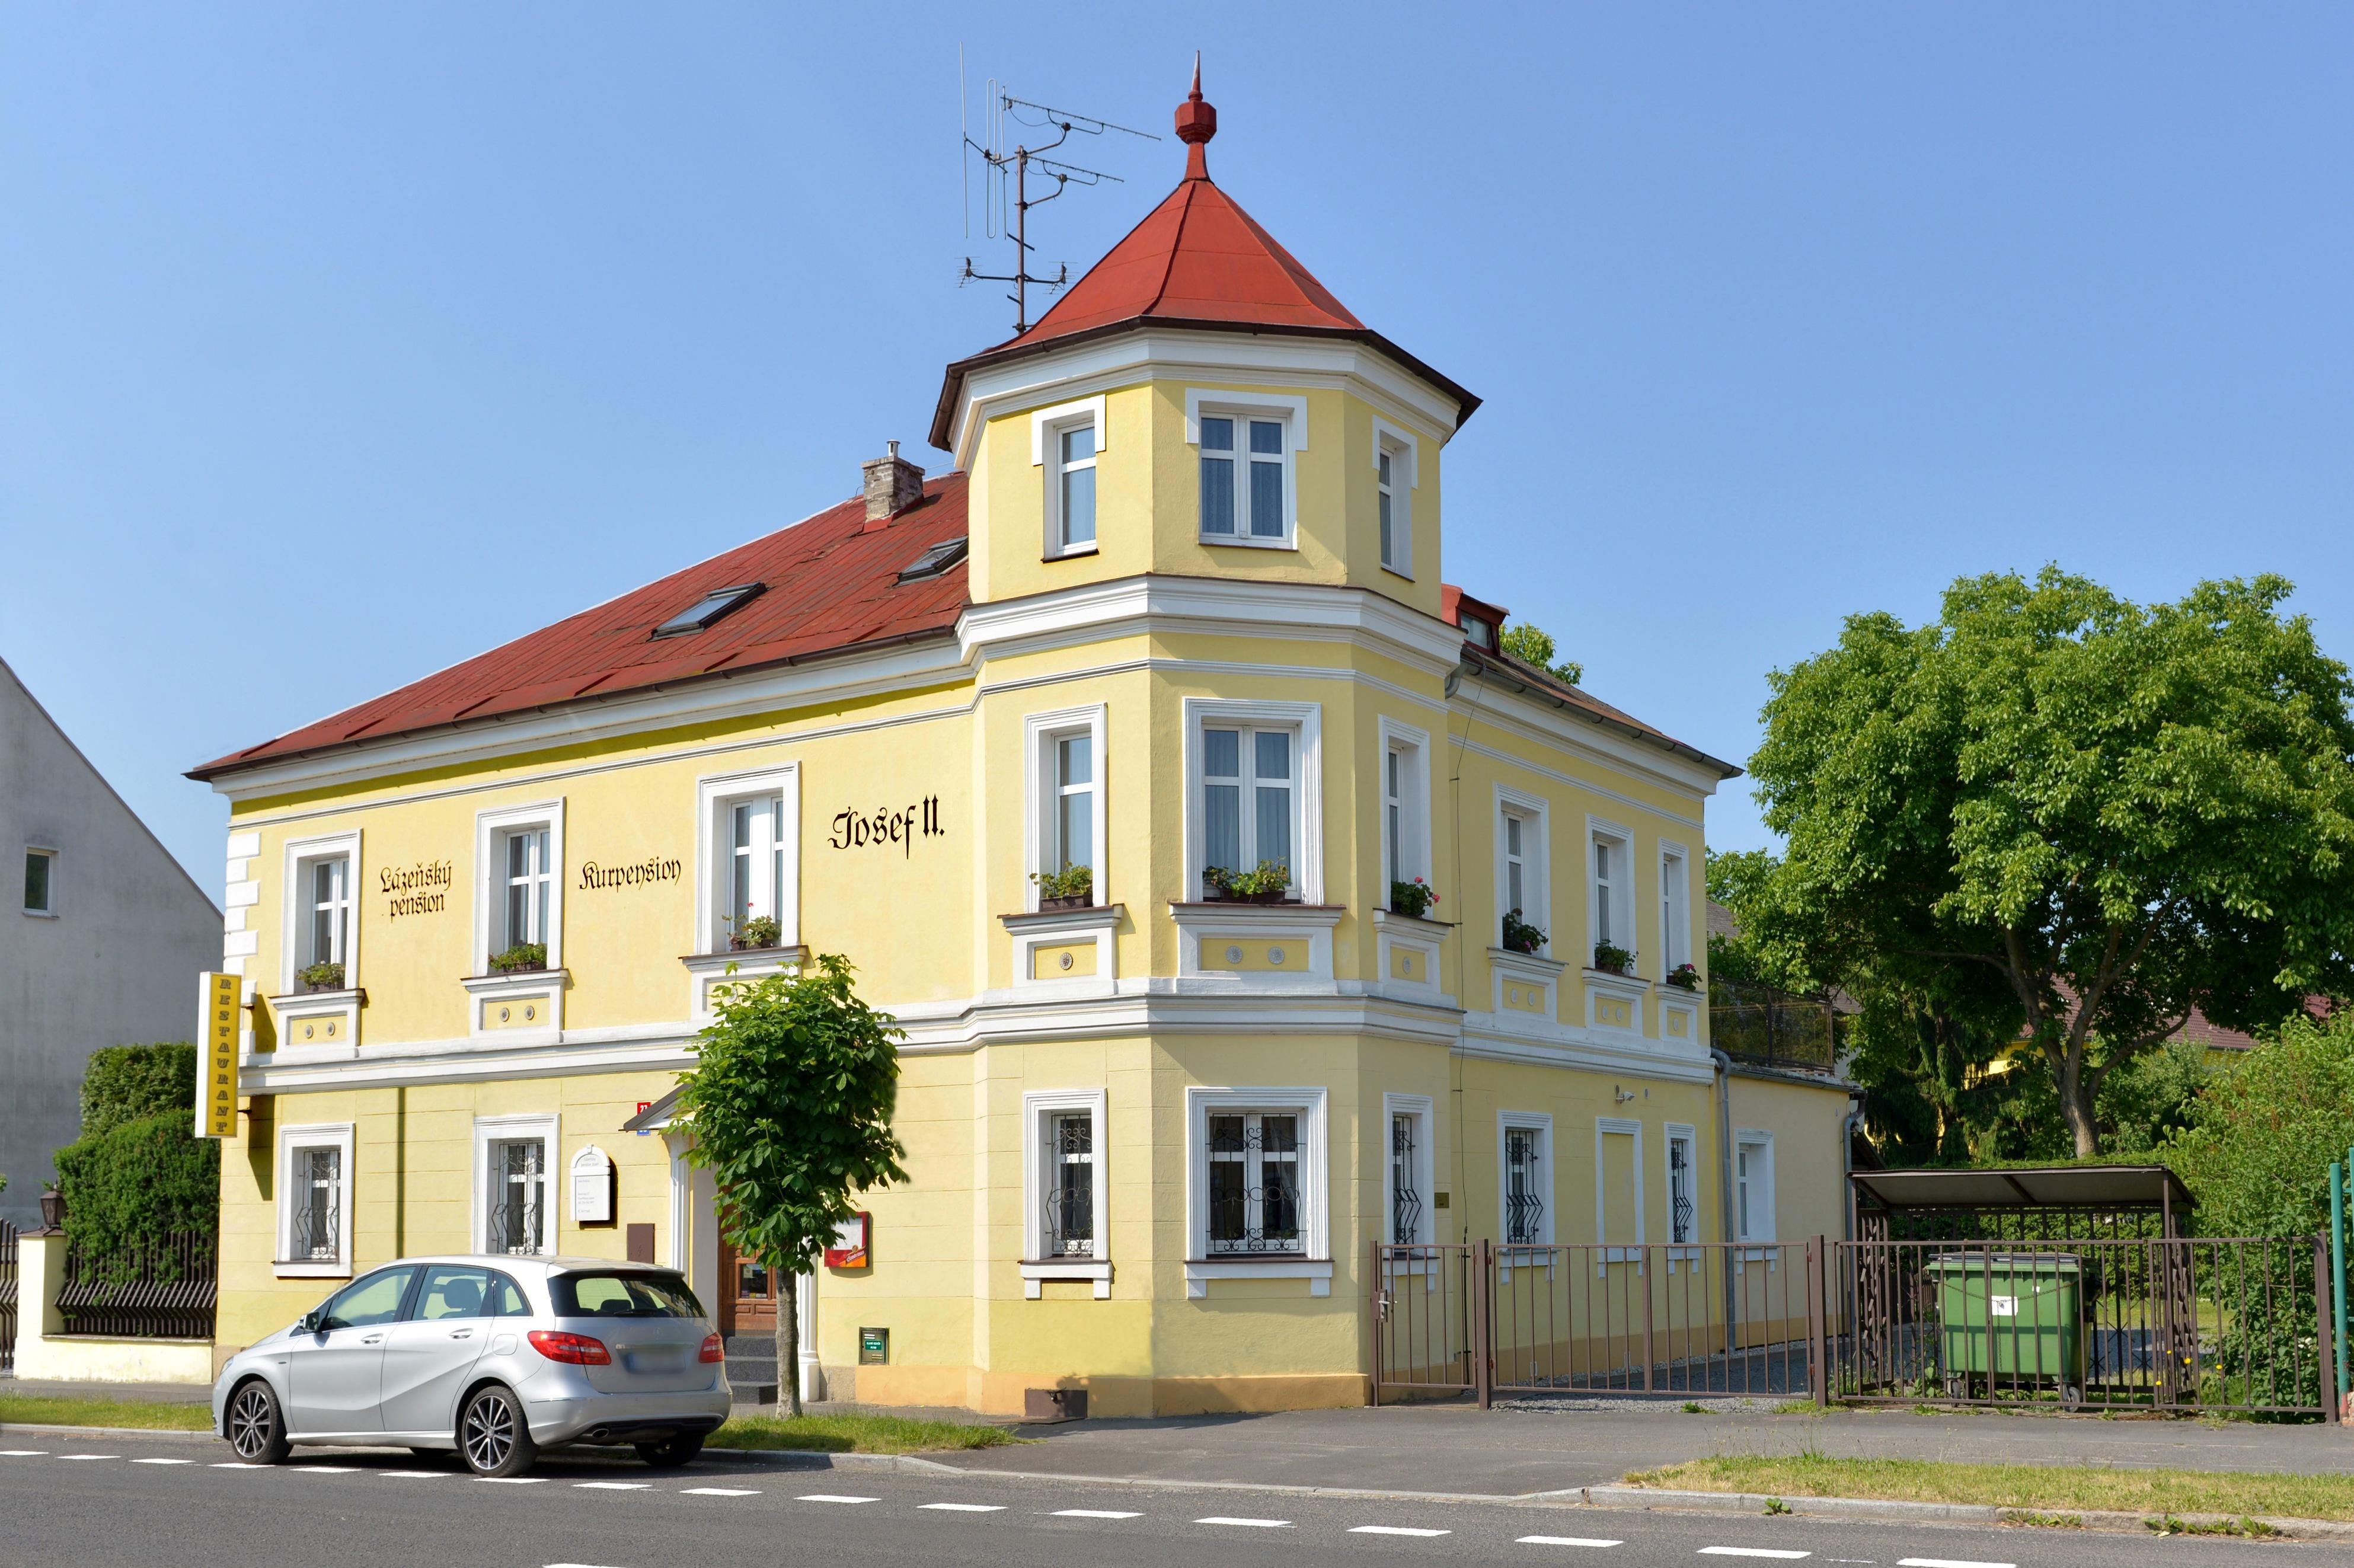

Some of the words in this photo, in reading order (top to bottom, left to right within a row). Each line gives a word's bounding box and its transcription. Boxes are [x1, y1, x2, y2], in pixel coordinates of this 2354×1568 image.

[828, 806, 916, 860] Josef
[922, 793, 945, 838] II.
[381, 860, 452, 896] Lázeňský
[579, 856, 682, 892] Kurpension
[390, 892, 445, 923] pension
[216, 979, 231, 1132] RESTAURANT
